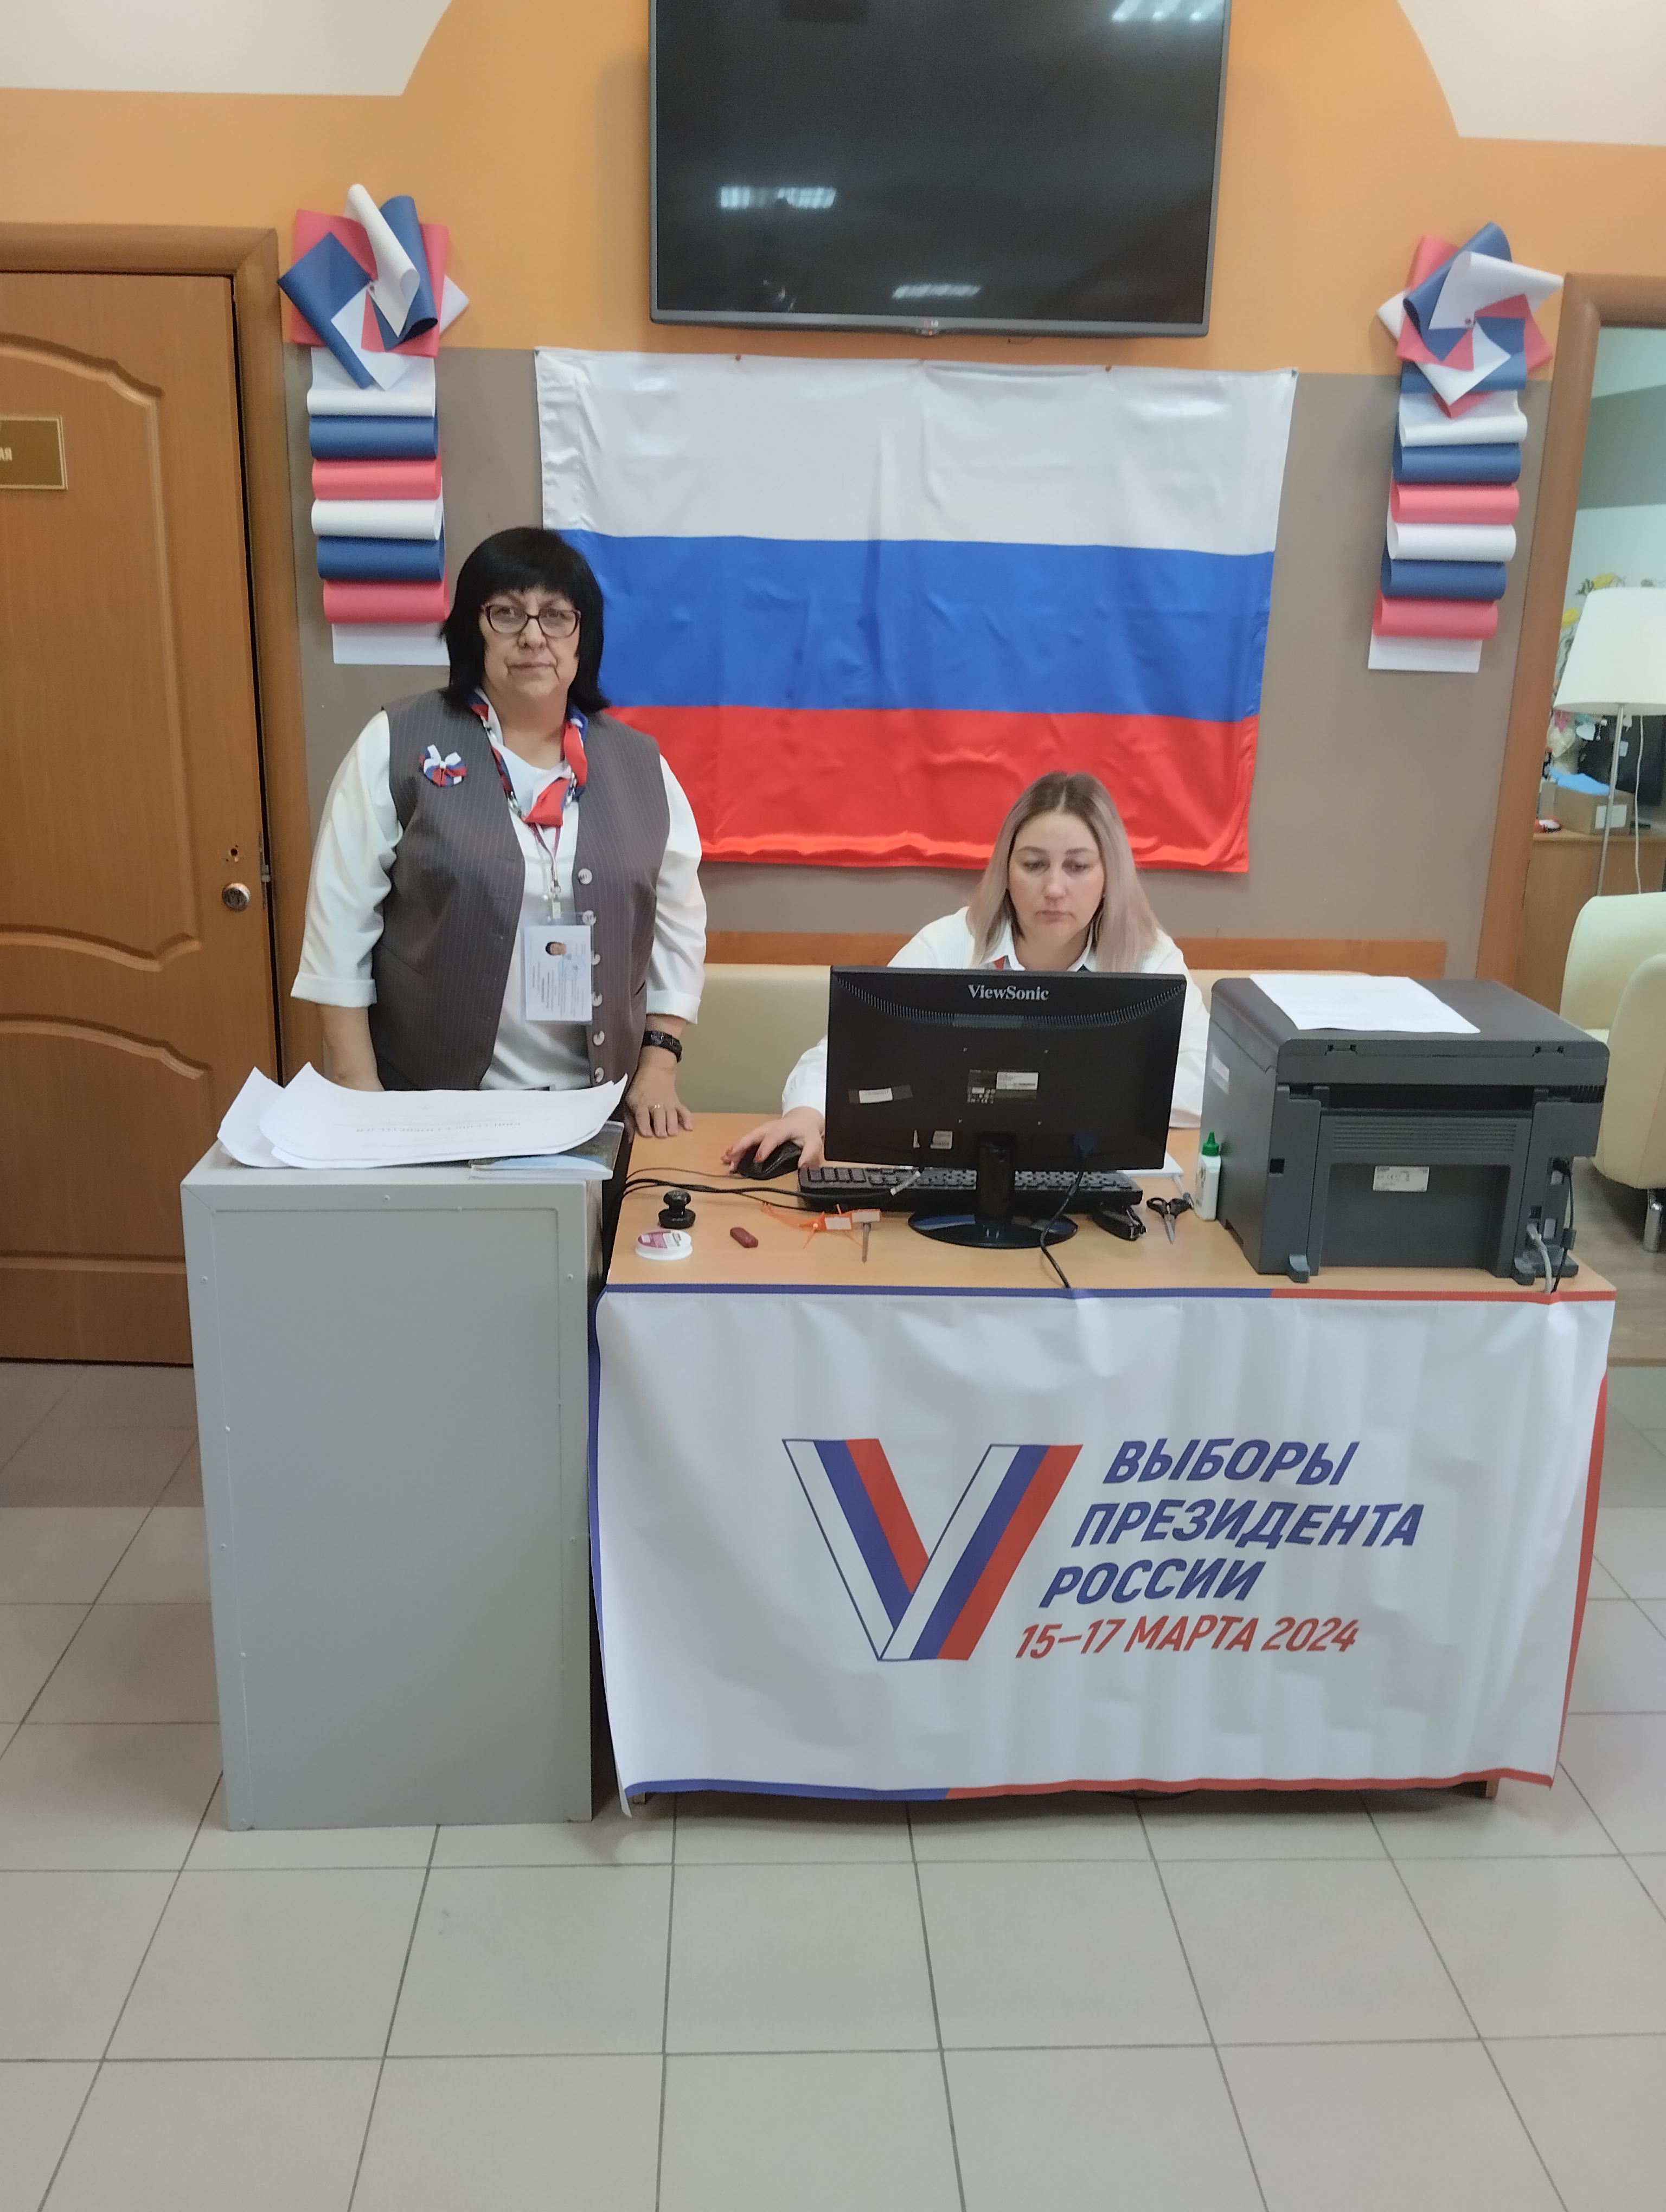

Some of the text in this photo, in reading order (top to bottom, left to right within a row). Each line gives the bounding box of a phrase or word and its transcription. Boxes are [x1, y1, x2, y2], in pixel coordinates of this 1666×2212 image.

[967, 984, 1049, 1001] ViewSonic
[1103, 1438, 1360, 1486] ВЫБОРЫ
[1071, 1499, 1425, 1549] ПРЕЗИДЕНТА
[1039, 1558, 1266, 1609] РОССИИ
[1124, 1614, 1259, 1652] МАРТА
[1261, 1616, 1360, 1652] 2024
